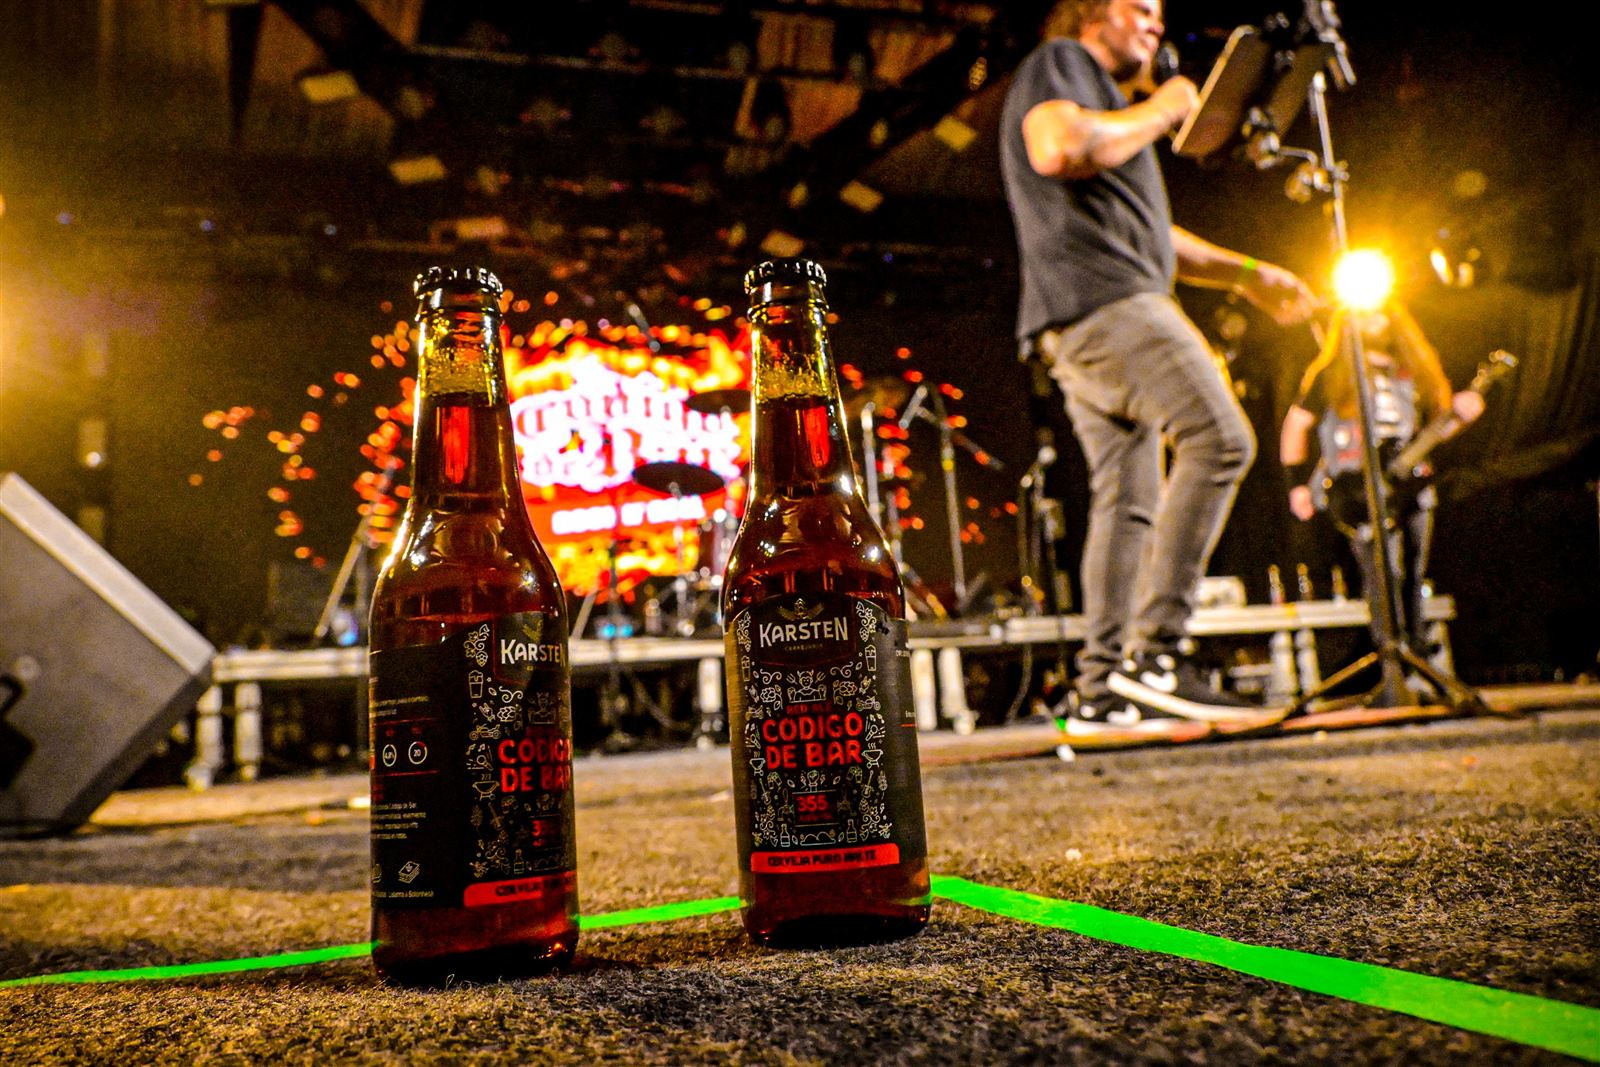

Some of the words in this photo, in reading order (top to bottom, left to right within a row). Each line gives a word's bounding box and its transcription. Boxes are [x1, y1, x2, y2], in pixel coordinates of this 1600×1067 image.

[759, 616, 849, 648] KARSTEN
[762, 711, 863, 742] CODIGO
[766, 745, 797, 770] DE
[805, 739, 863, 768] BAR
[501, 767, 535, 793] DE
[797, 794, 829, 812] 355
[813, 854, 842, 864] PURO
